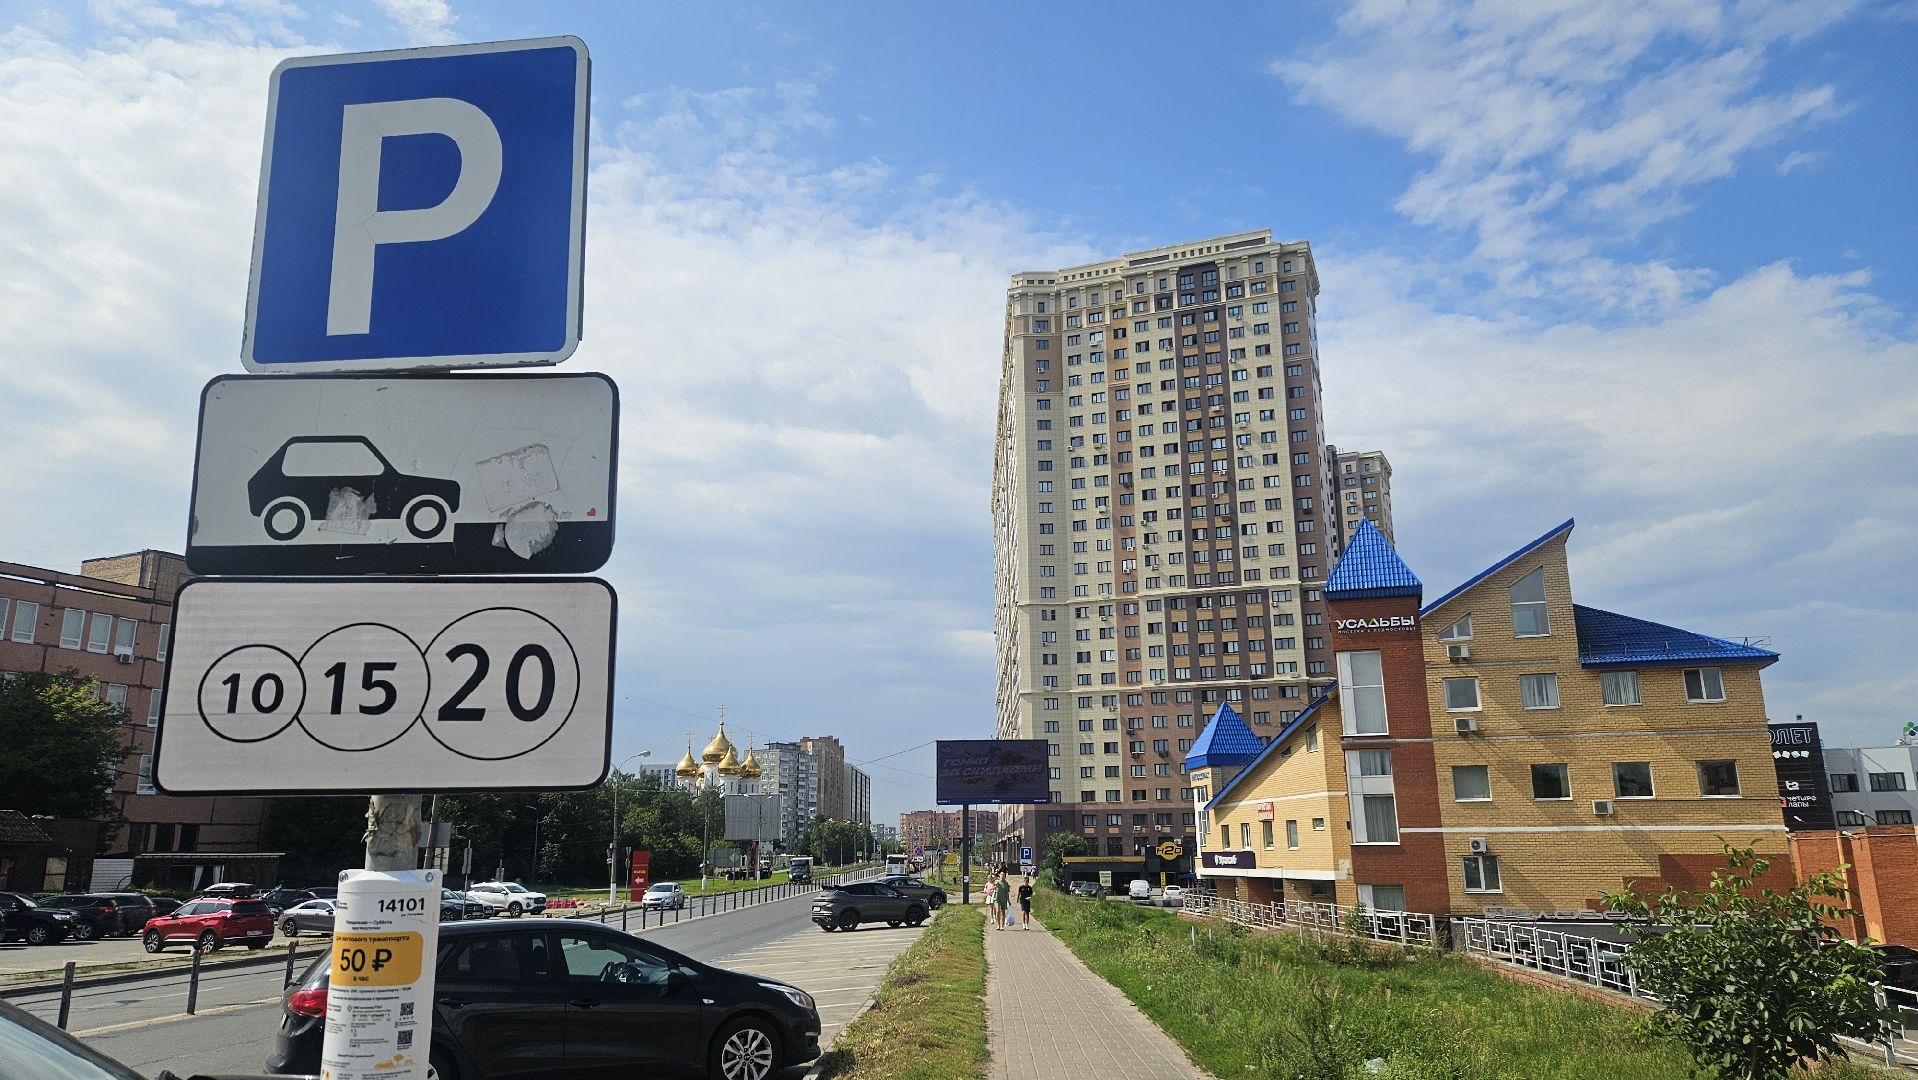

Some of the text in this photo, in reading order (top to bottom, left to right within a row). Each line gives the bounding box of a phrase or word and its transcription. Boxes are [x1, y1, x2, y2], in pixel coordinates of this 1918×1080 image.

[326, 97, 503, 336] P
[1336, 615, 1415, 630] УСАДЬБЫ
[221, 643, 556, 722] 10 15 20
[1023, 848, 1030, 859] P
[378, 897, 425, 913] 14101
[339, 948, 366, 972] 50
